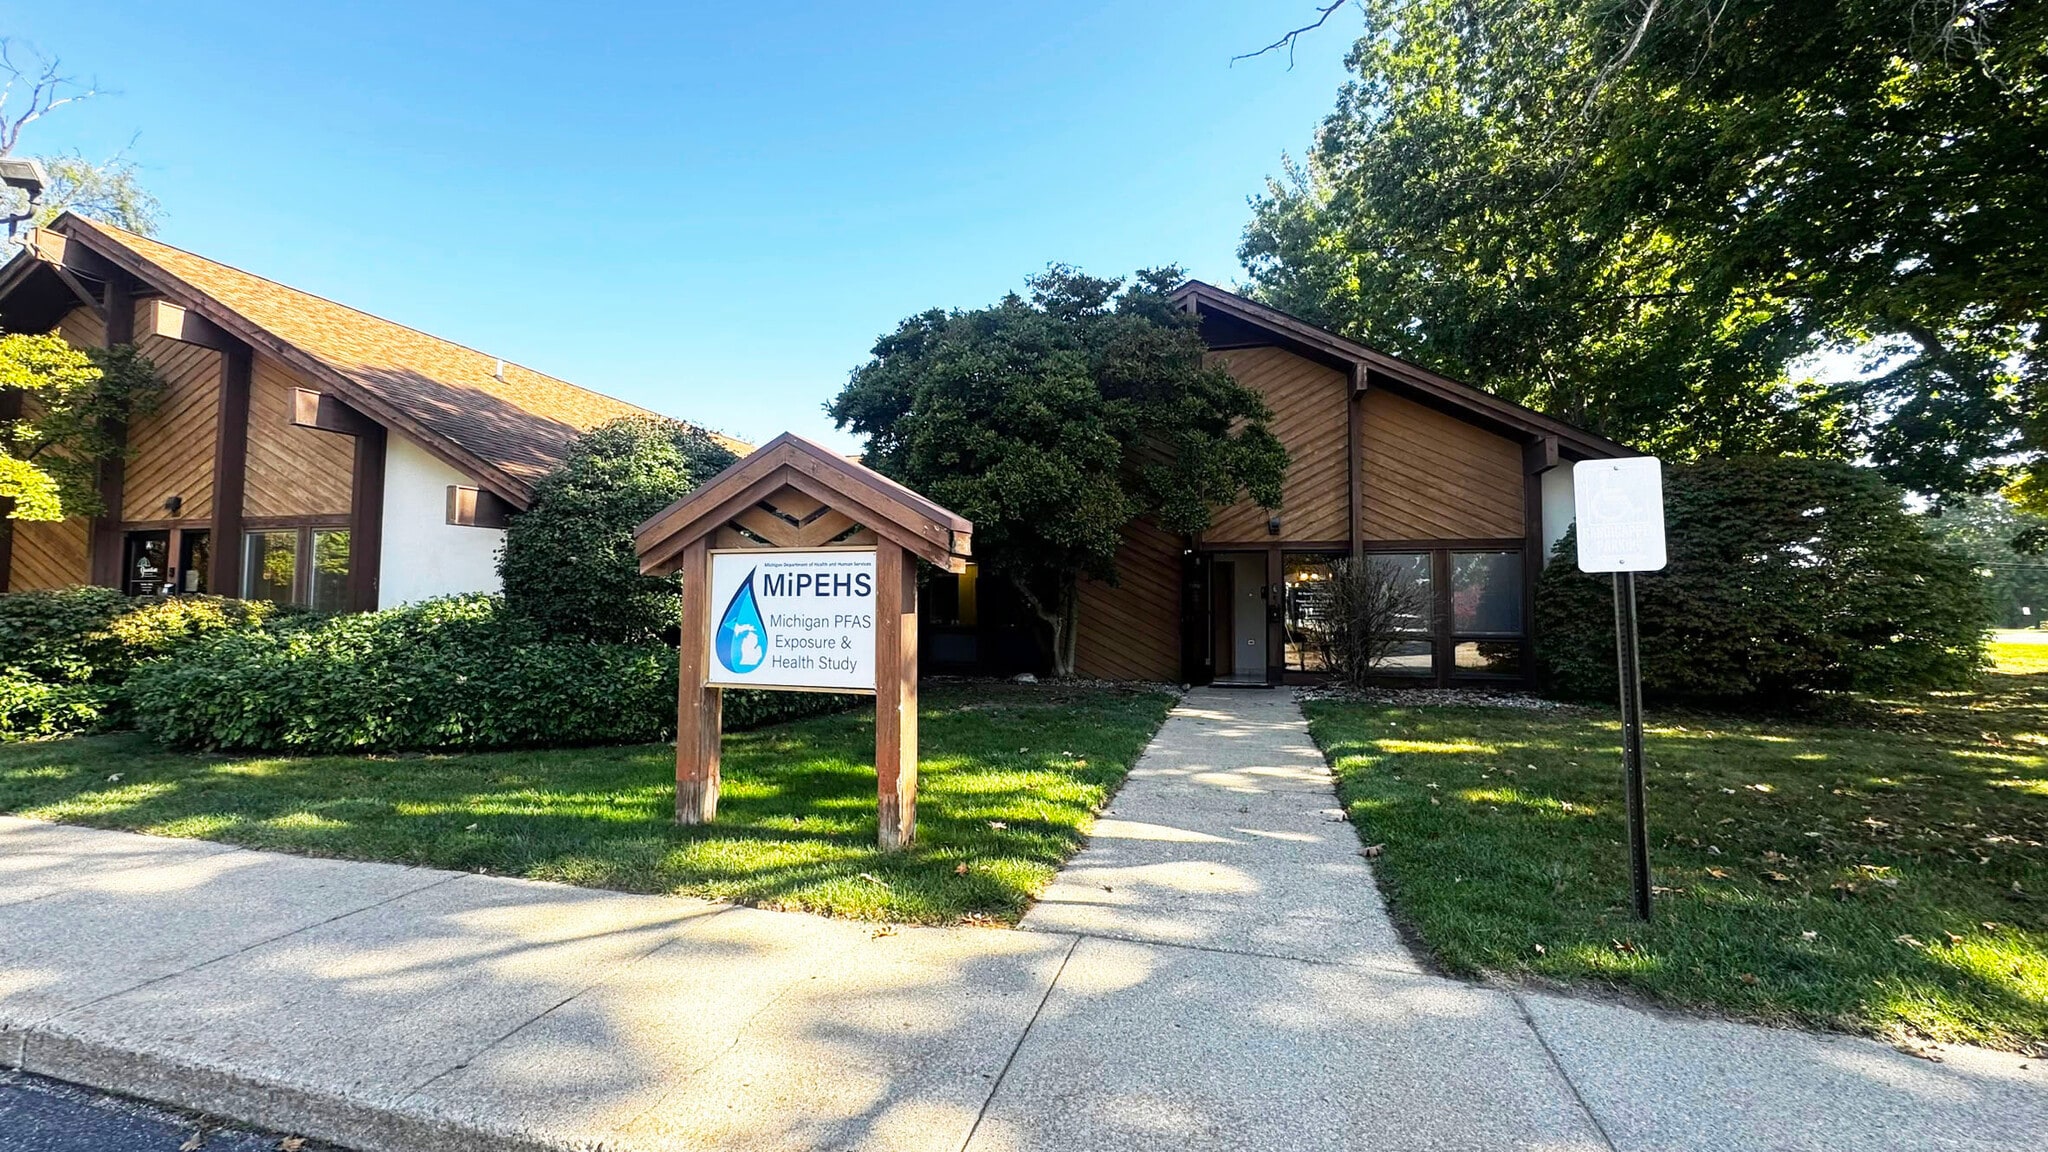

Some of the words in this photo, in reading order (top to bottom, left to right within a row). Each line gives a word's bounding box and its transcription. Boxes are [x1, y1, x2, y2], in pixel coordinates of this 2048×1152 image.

[763, 572, 872, 597] MiPEHS
[770, 613, 830, 631] Michigan
[834, 614, 872, 629] PFAS
[775, 635, 836, 651] Exposure
[840, 635, 852, 650] &
[772, 655, 814, 670] Health
[818, 655, 858, 674] Study
